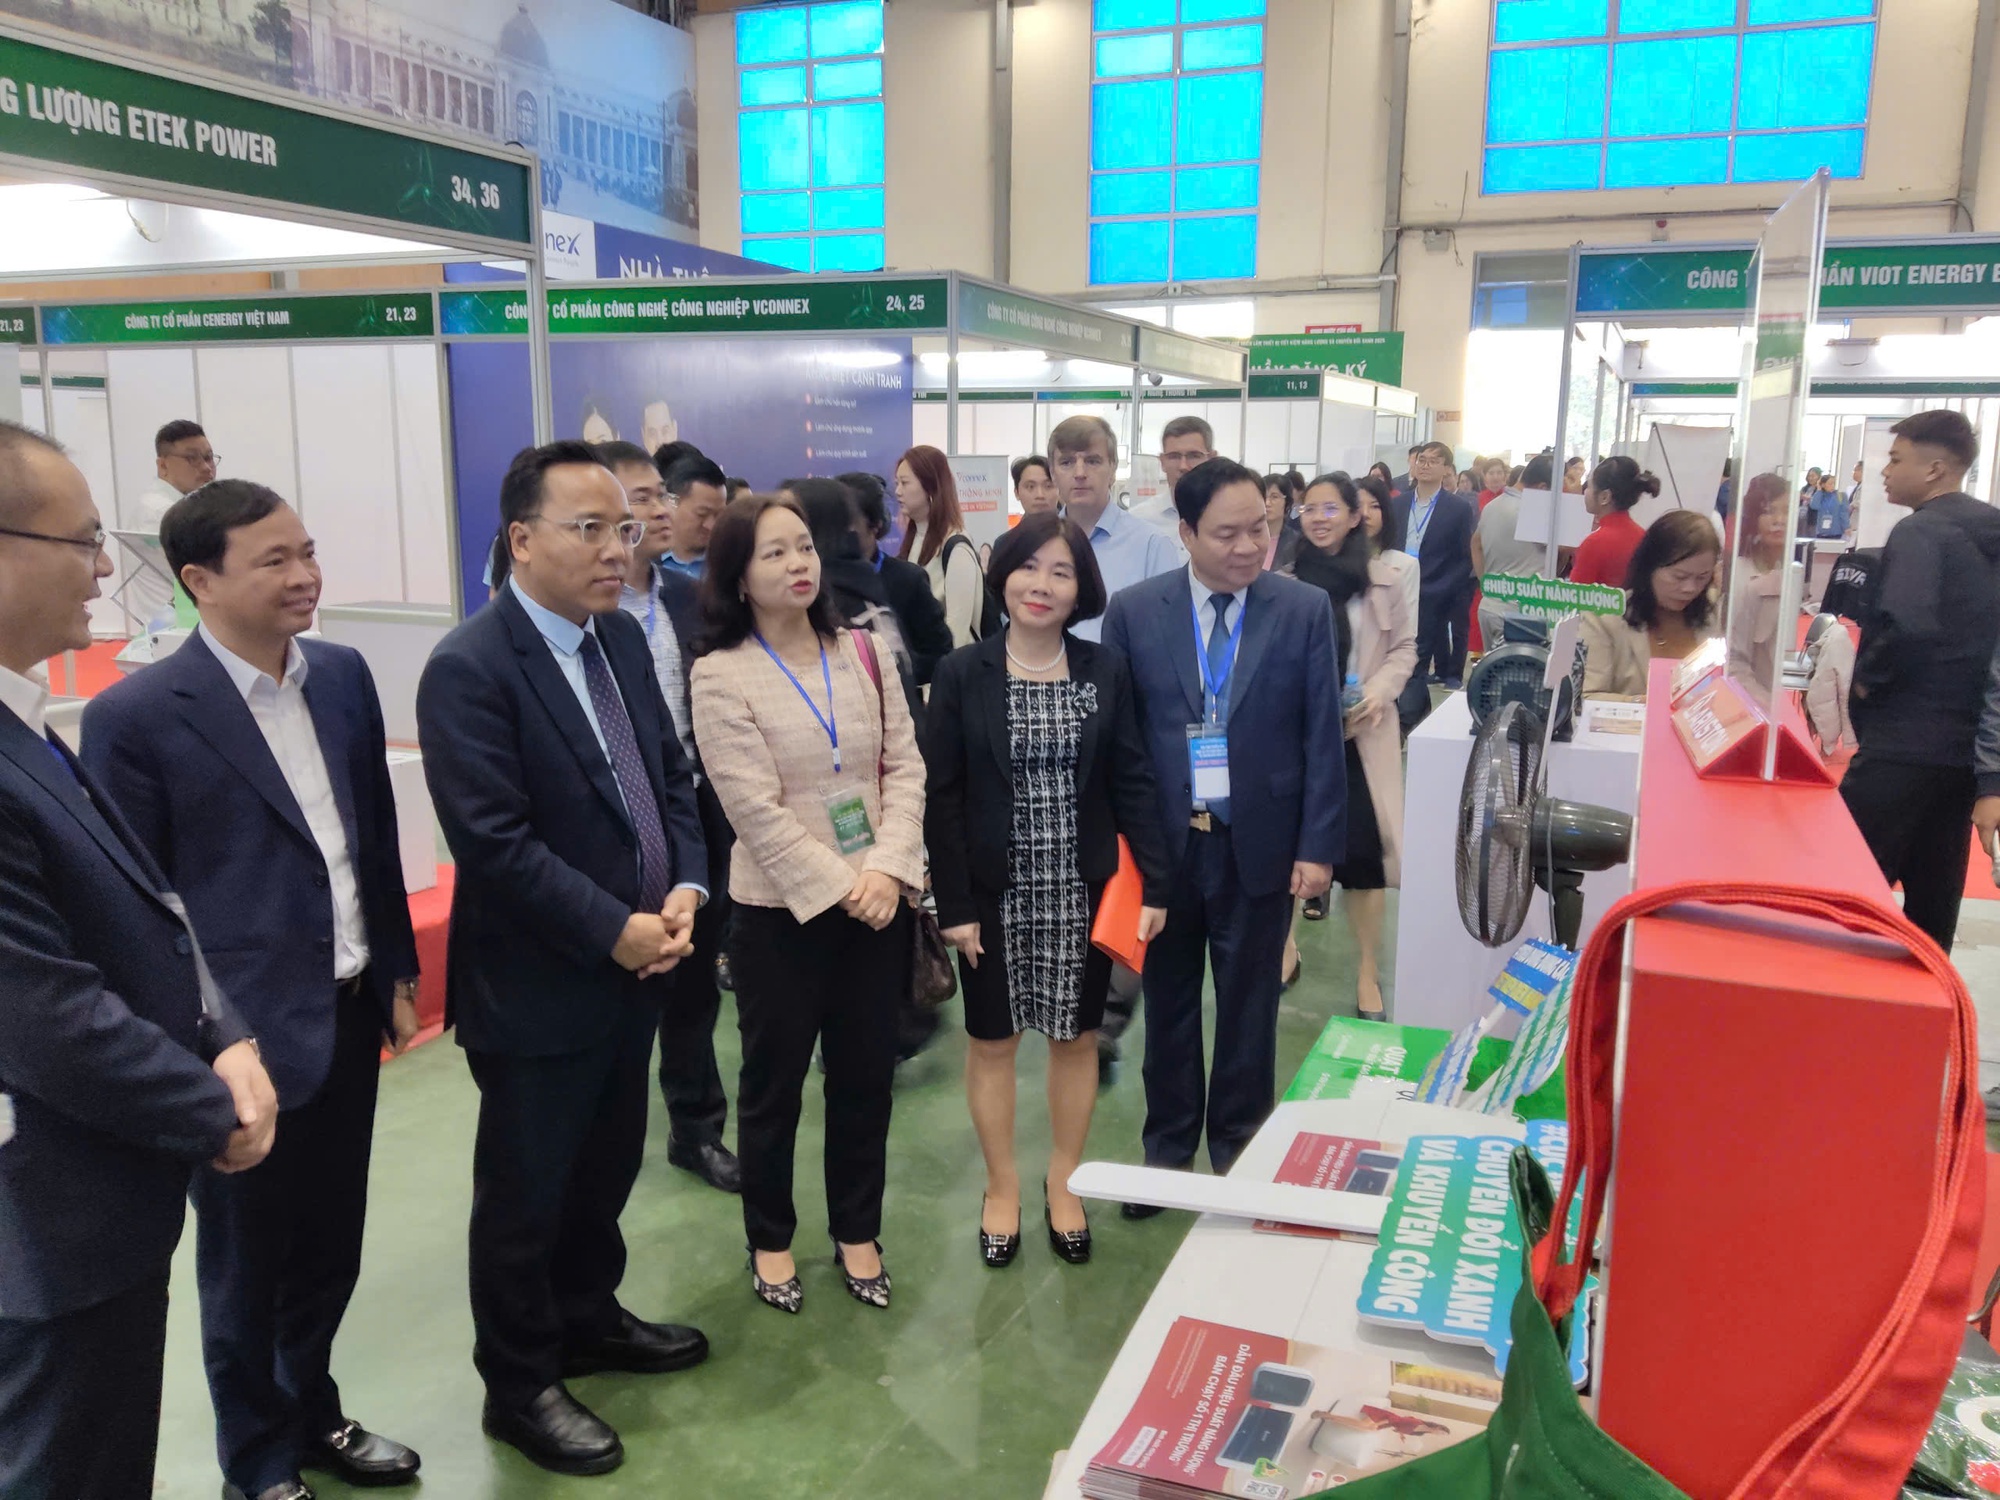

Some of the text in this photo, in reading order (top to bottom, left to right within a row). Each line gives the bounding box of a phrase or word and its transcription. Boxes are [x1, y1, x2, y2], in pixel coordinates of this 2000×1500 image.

[26, 83, 121, 136] LƯỢNG
[127, 105, 189, 150] ETEK
[194, 120, 277, 167] POWER
[450, 175, 500, 210] 34, 36
[1687, 264, 1738, 290] CÔNG
[1860, 265, 1904, 286] VIOT
[1907, 263, 1988, 285] ENERGY
[385, 306, 417, 322] 21, 23
[504, 297, 810, 320] CÔN CỔ PHẦN CÔNG NGHỆ CÔNG NGHIỆP VCONNEX
[886, 294, 925, 312] 24, 25
[13, 319, 24, 331] 23
[124, 309, 290, 330] CÔNG TY CỔ PHẦN CENERGY VIỆT NAM
[1345, 359, 1367, 377] KÝ
[877, 372, 902, 389] TRANH
[1483, 578, 1620, 611] #HIỆU SUẤT NĂNG LƯỢNG
[1418, 1138, 1464, 1162] VÀ
[1394, 1163, 1454, 1248] KHUYẾN
[1459, 1216, 1519, 1258] ĐỔI
[1373, 1249, 1436, 1315] CÔNG
[1443, 1258, 1500, 1332] XANH
[1211, 1355, 1227, 1375] BÁN
[1201, 1375, 1219, 1400] CHẠY
[1182, 1344, 1251, 1474] DẪN ĐẦU HIỆU SUẤT NĂNG LƯỢNG
[1194, 1399, 1209, 1413] SỐ
[1183, 1418, 1201, 1432] THỊ
[1169, 1432, 1192, 1463] TRƯỜNG
